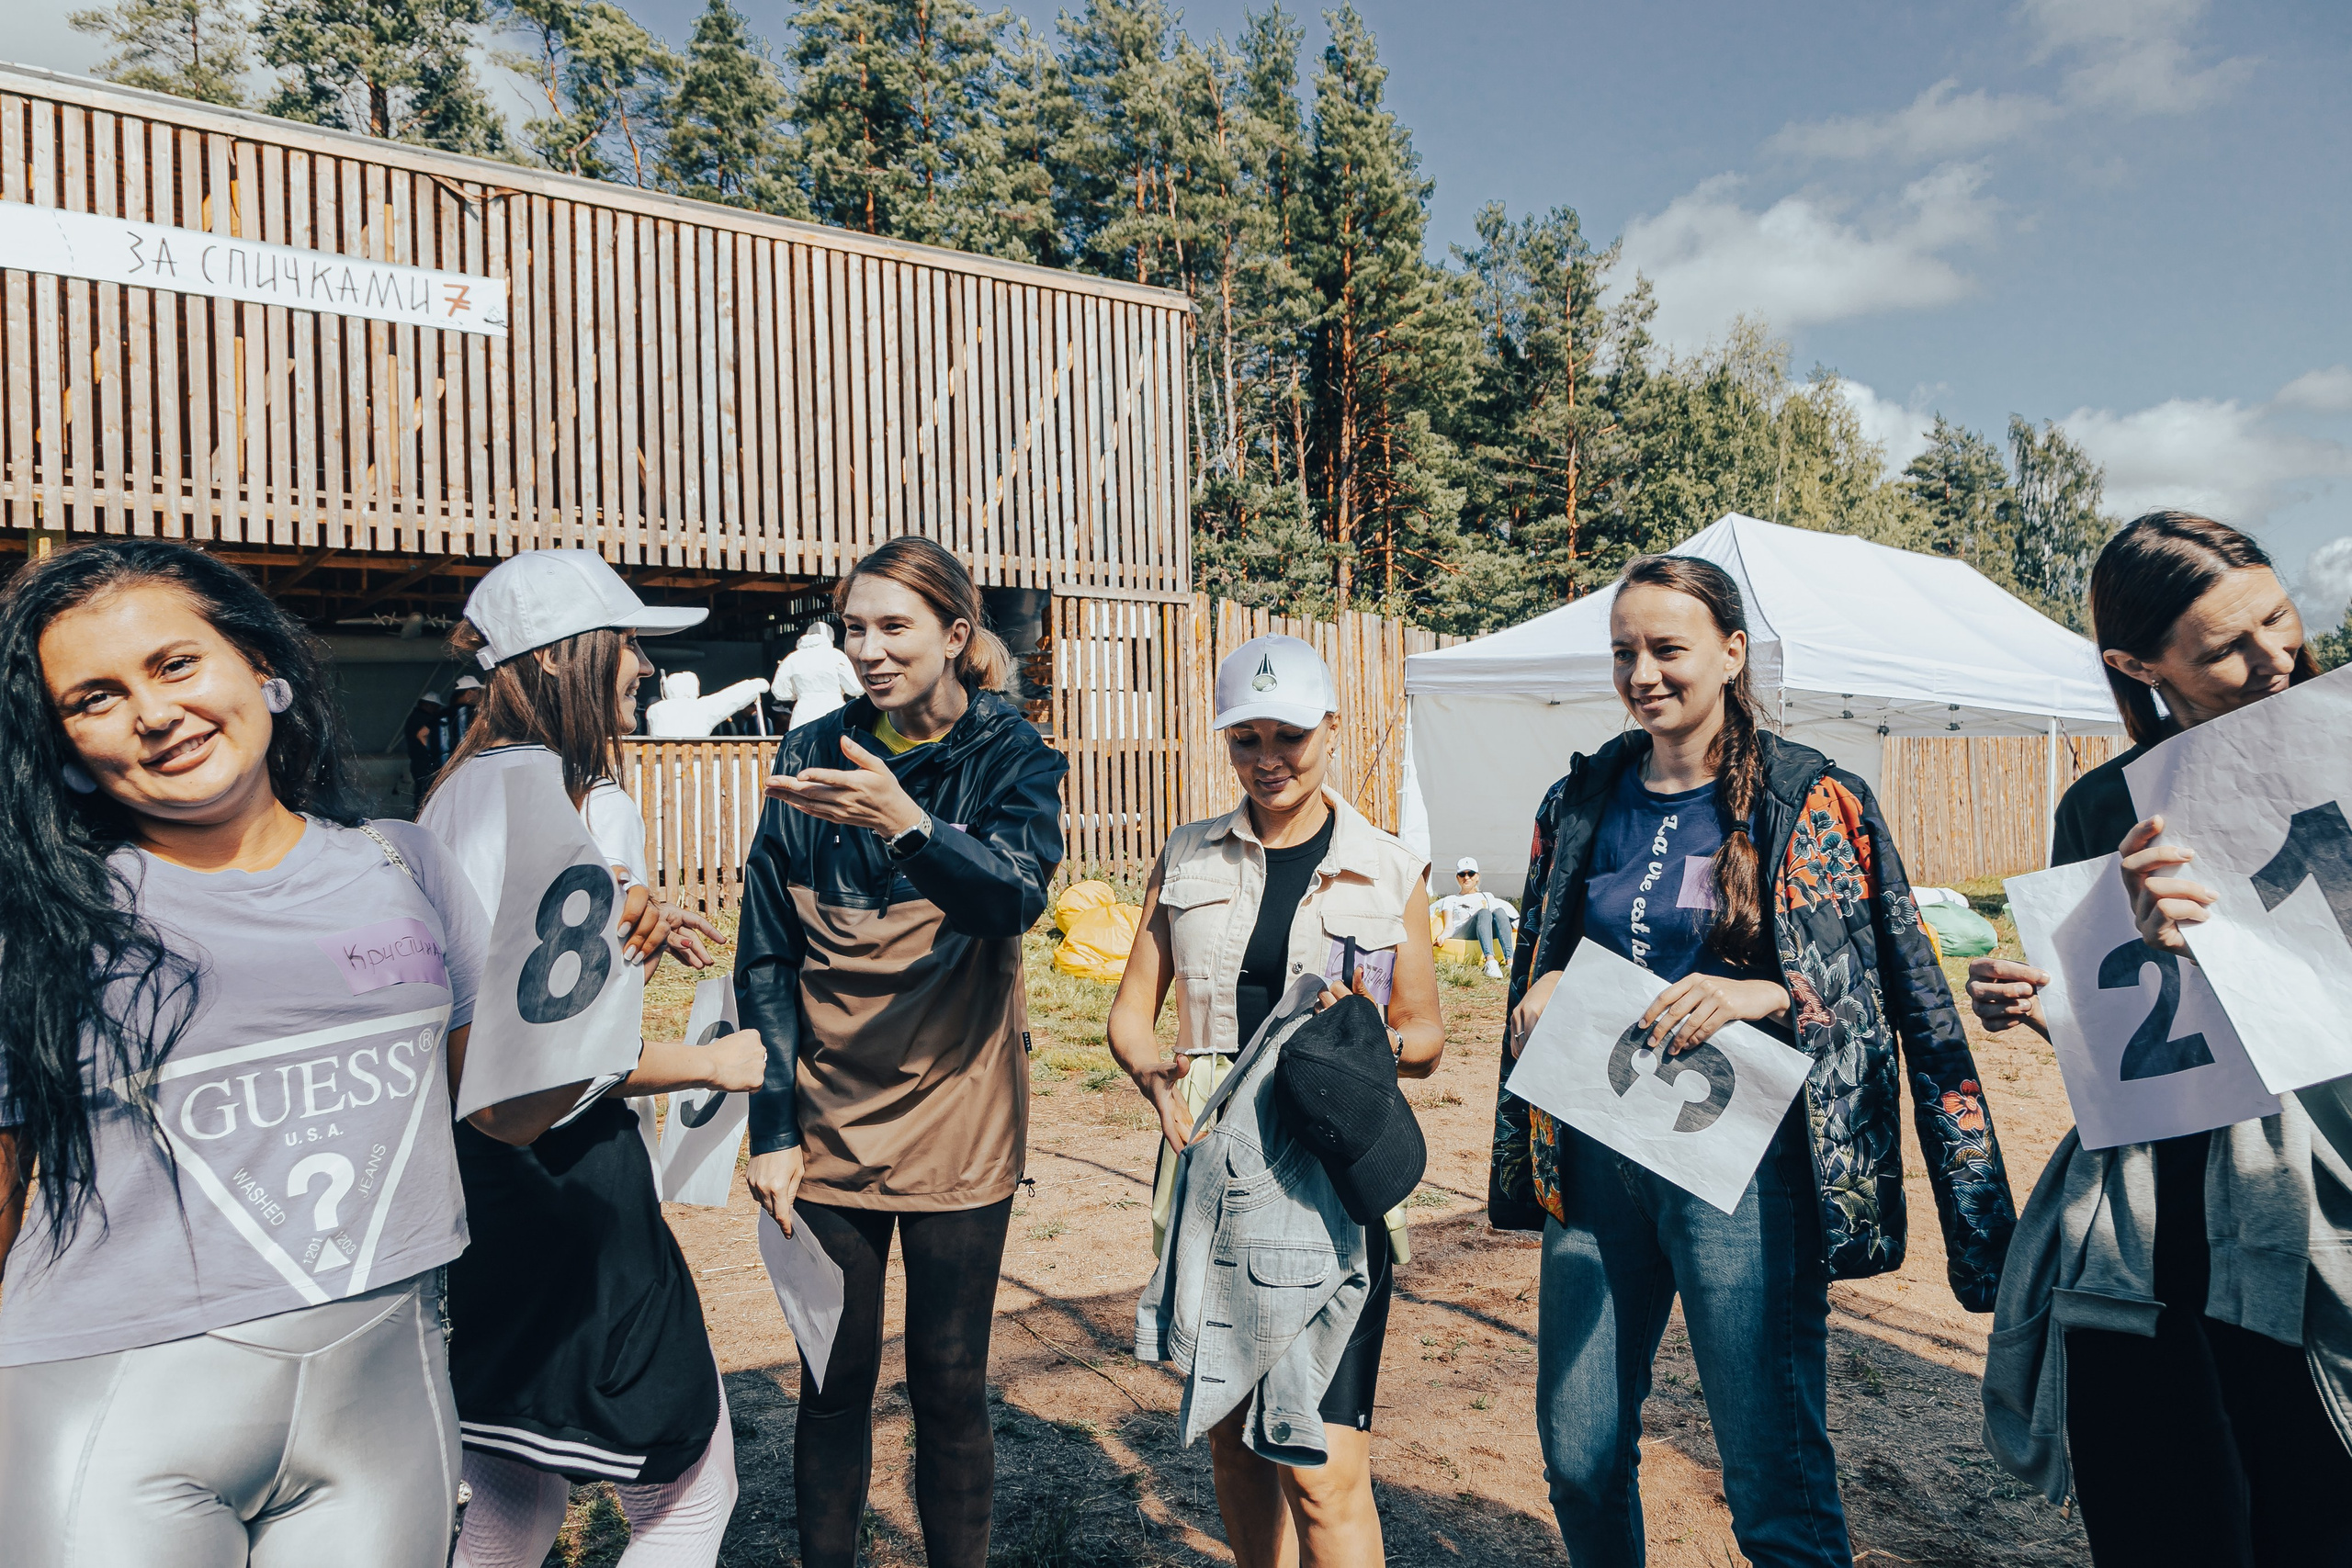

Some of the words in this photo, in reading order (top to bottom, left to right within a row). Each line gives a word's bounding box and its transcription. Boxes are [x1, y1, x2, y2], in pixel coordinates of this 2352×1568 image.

[127, 231, 177, 277] ЗА
[201, 245, 430, 315] СПИЧКАМИ
[1652, 815, 1679, 856] La
[1639, 862, 1663, 892] vie
[516, 863, 615, 1024] 8
[2098, 937, 2215, 1082] 2
[1608, 1017, 1736, 1133] 3
[232, 1167, 287, 1226] WASHED
[357, 1143, 386, 1199] JEANS
[302, 1237, 323, 1264] 1201
[334, 1230, 356, 1255] 1203
